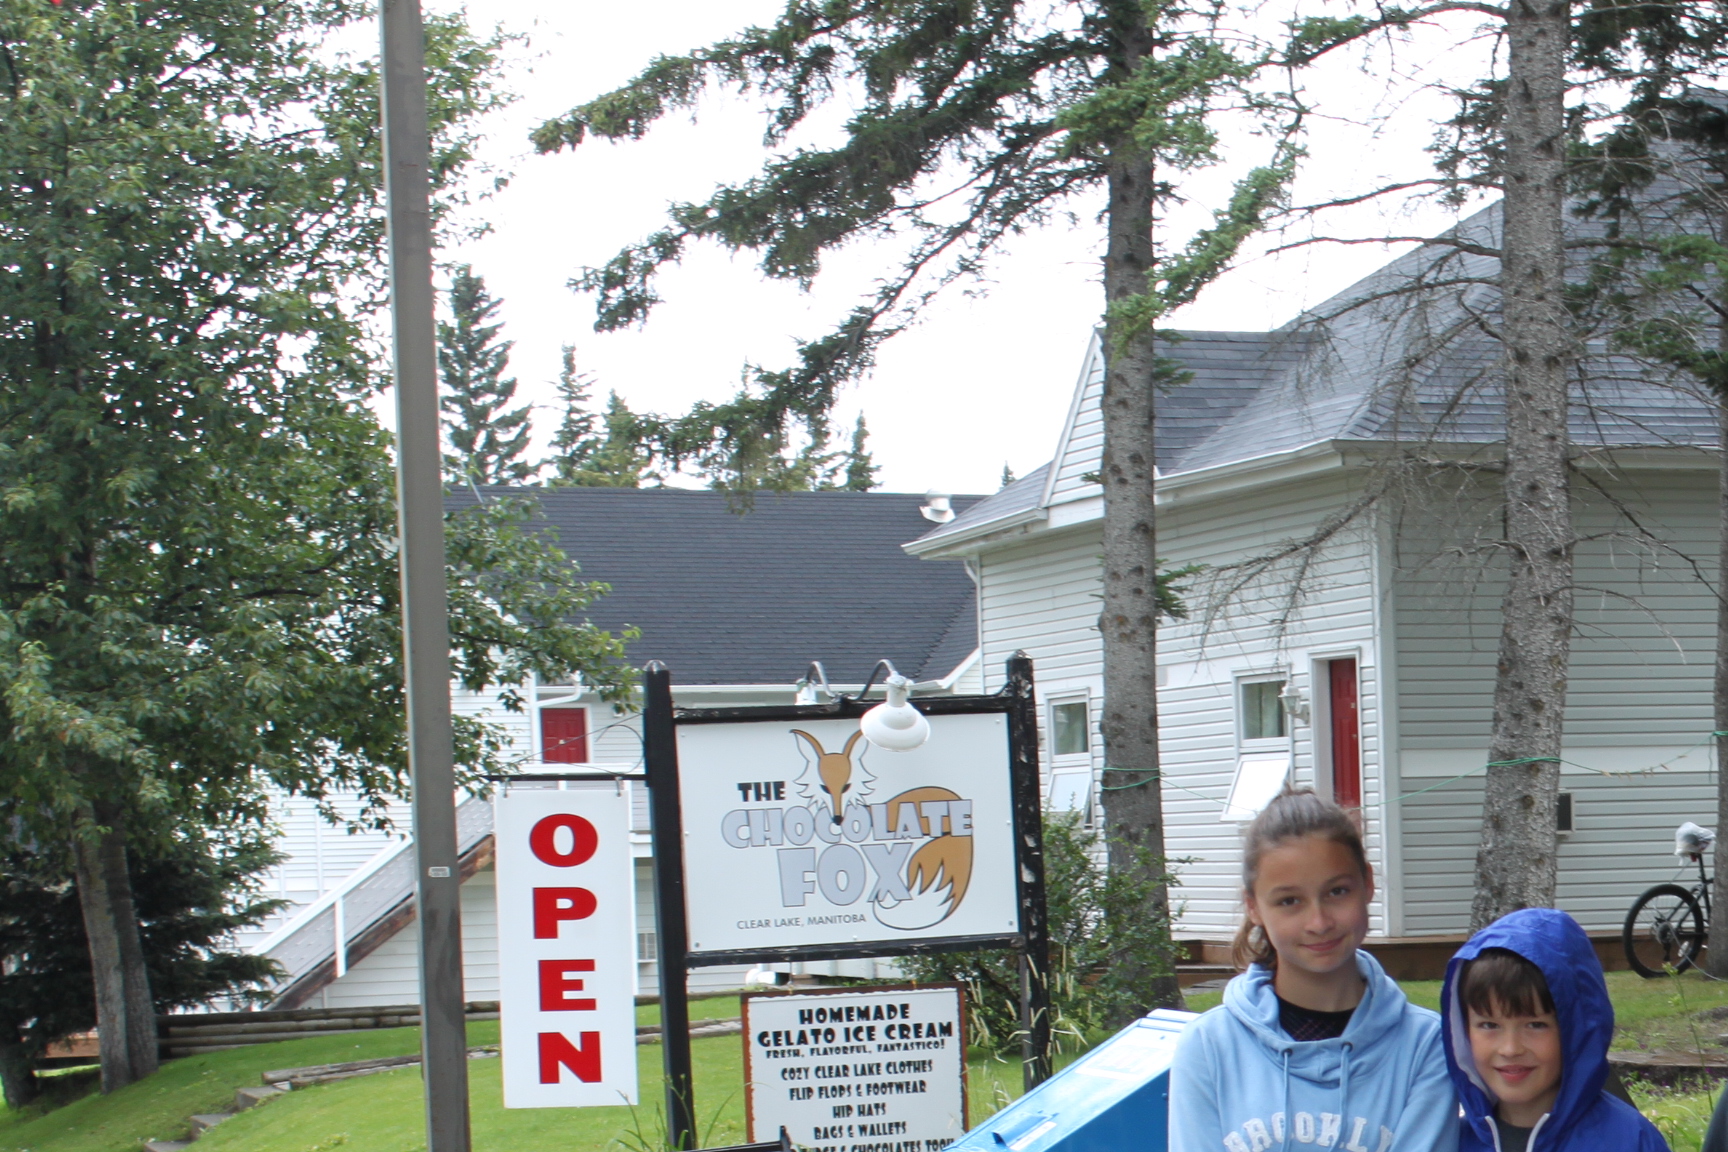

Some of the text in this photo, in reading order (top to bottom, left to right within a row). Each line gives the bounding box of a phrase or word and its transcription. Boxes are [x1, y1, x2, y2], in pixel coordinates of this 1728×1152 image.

[737, 781, 786, 802] THE
[721, 799, 973, 849] CHOCOLATE
[776, 842, 914, 908] FOX
[737, 914, 867, 930] CLEAR LAKE, MANITOBA
[529, 813, 603, 1085] OPEN
[798, 1003, 911, 1025] HOMEMADE
[757, 1021, 953, 1048] GELATO ICE CREAM
[766, 1039, 945, 1059] FRESH, FLAVORFUL, FANTASTICO!
[781, 1059, 933, 1081] COZY CLEAR LAKE CLOTHES
[789, 1079, 927, 1101] FLIP FLOPS & FOOTWEAR
[832, 1102, 887, 1119] HIP HATS
[813, 1121, 907, 1140] BAGS & WALLETS
